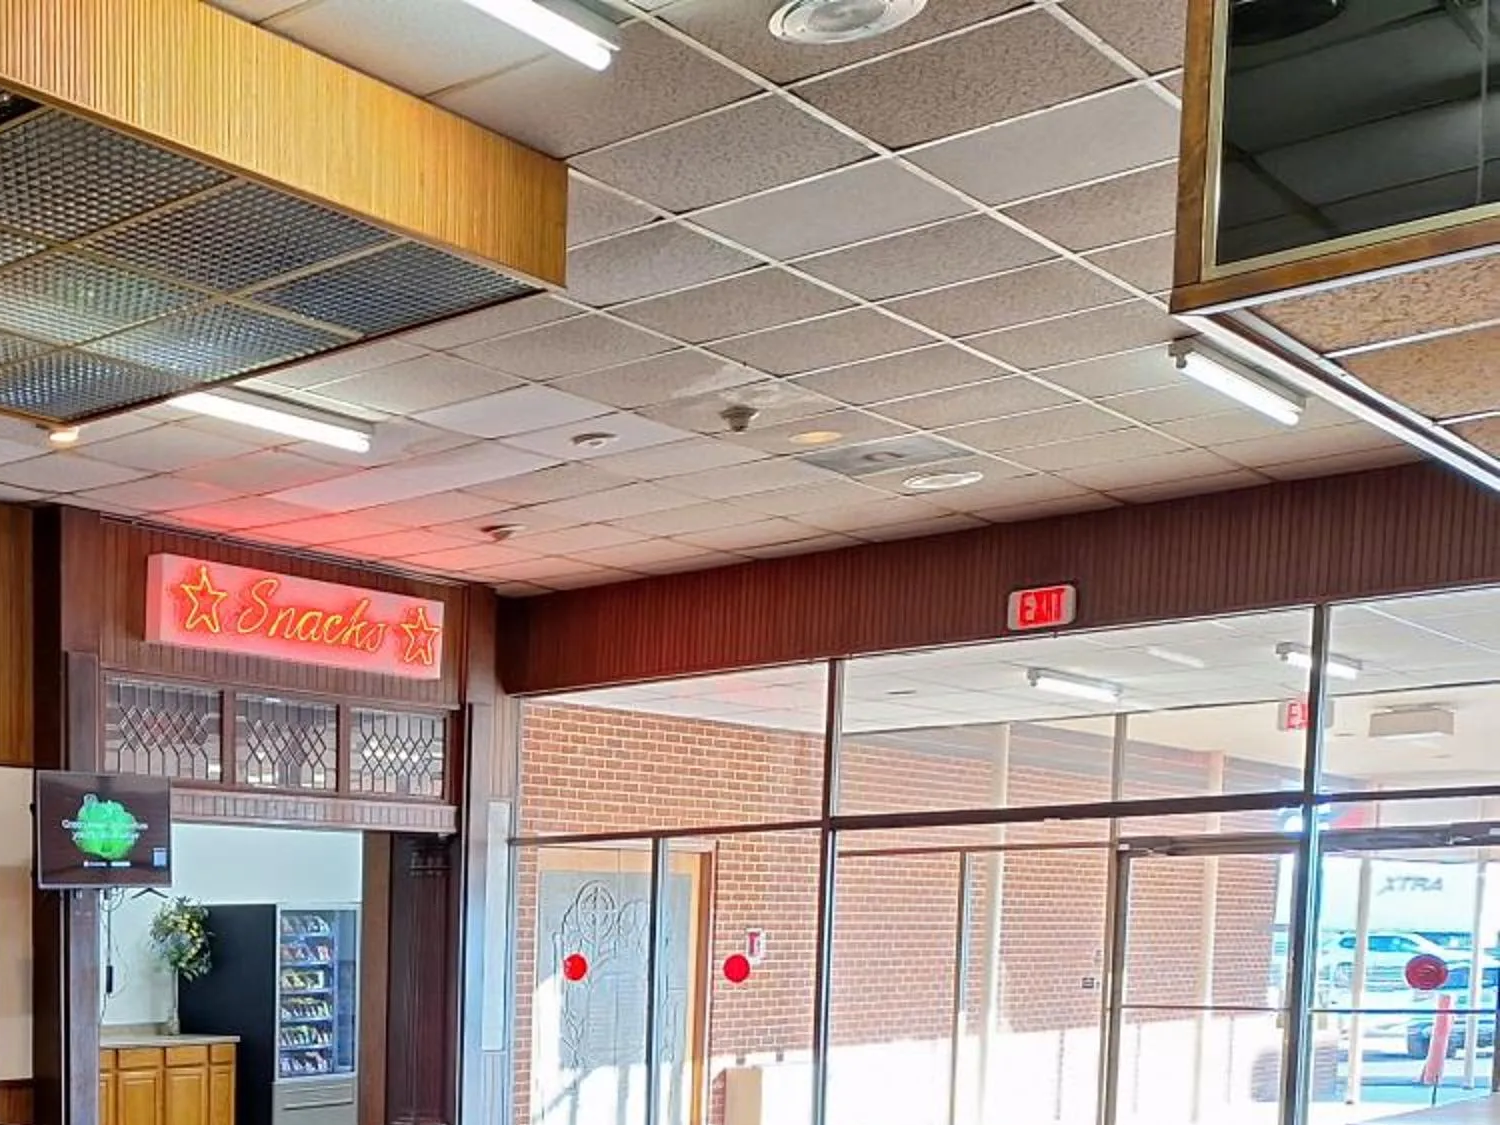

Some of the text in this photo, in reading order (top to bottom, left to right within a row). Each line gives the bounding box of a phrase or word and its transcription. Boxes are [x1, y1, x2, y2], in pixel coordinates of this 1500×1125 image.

[237, 578, 387, 652] Snacks
[1020, 588, 1065, 626] EXIT
[1377, 875, 1444, 896] XTRA
